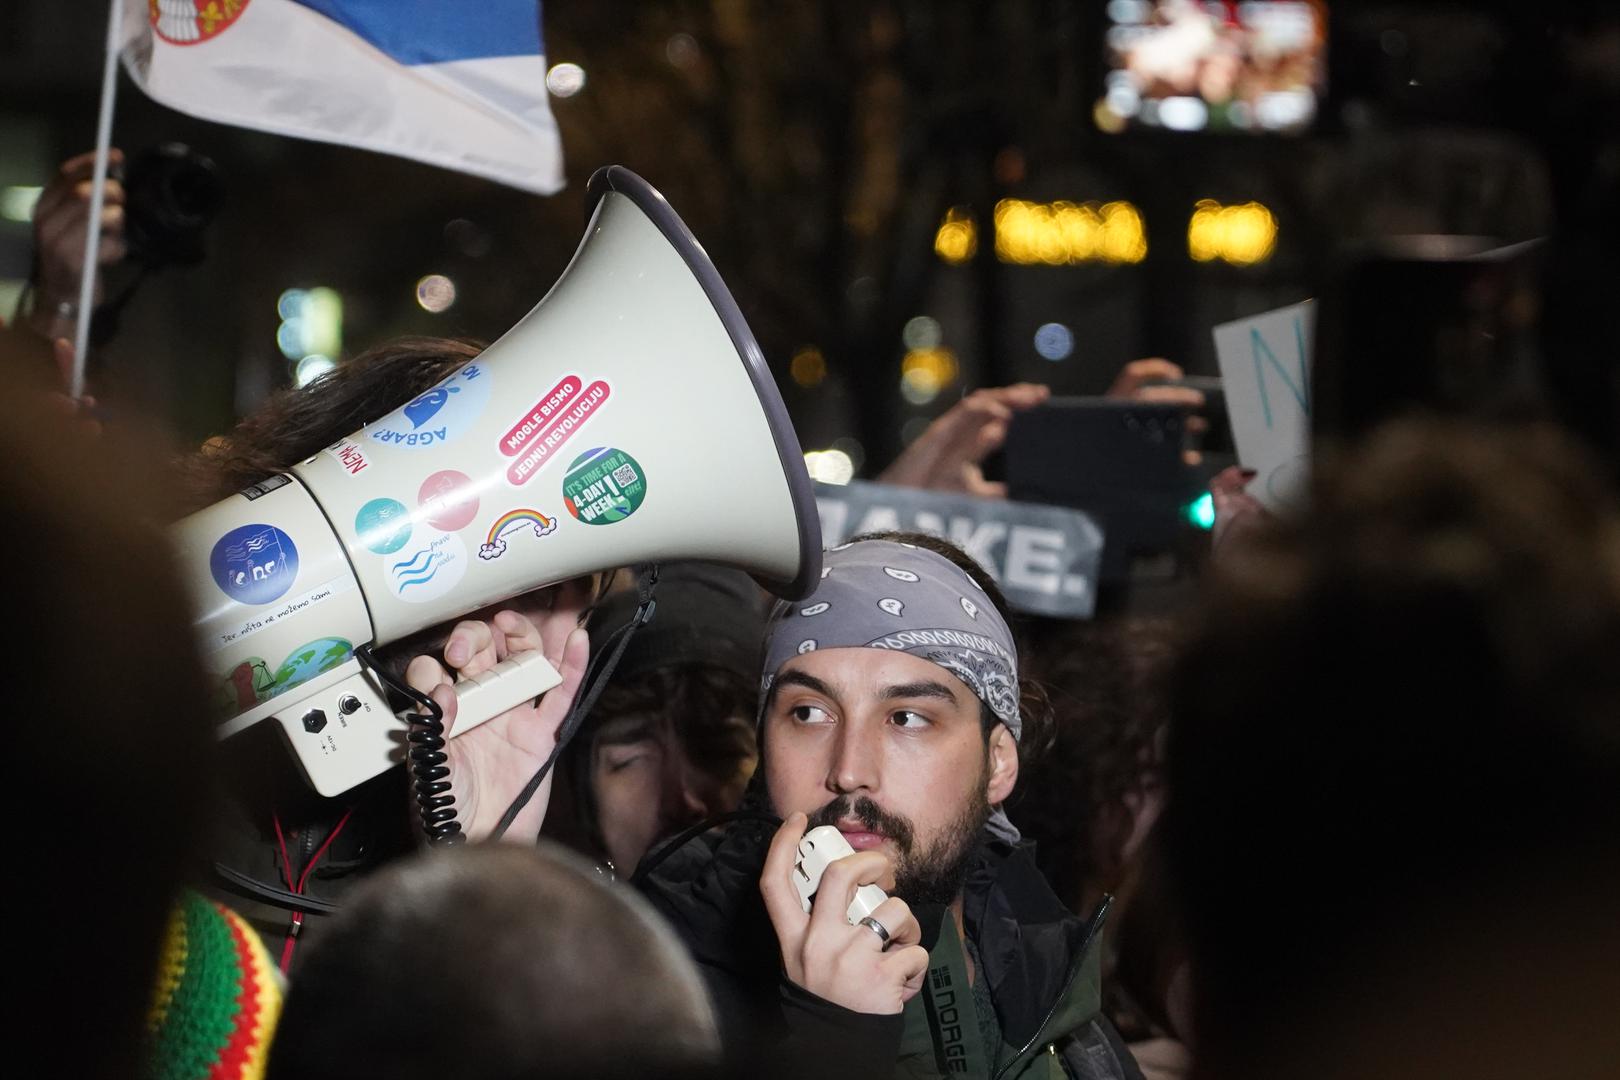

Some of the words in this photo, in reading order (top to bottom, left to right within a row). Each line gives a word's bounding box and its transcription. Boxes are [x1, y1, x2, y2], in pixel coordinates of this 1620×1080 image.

[373, 426, 447, 446] AGBAR?
[507, 413, 544, 449] MOGLE
[540, 383, 574, 417] BISMO
[514, 444, 547, 480] JEDNU
[545, 386, 604, 448] REVOLUCIJU
[566, 480, 583, 496] IT'S
[580, 467, 603, 486] TIME
[601, 457, 620, 474] FOR
[617, 453, 626, 464] A
[573, 479, 606, 508] 4-DAY
[265, 615, 275, 624] ne
[277, 604, 309, 618] možemo
[936, 990, 967, 1073] NORGE
